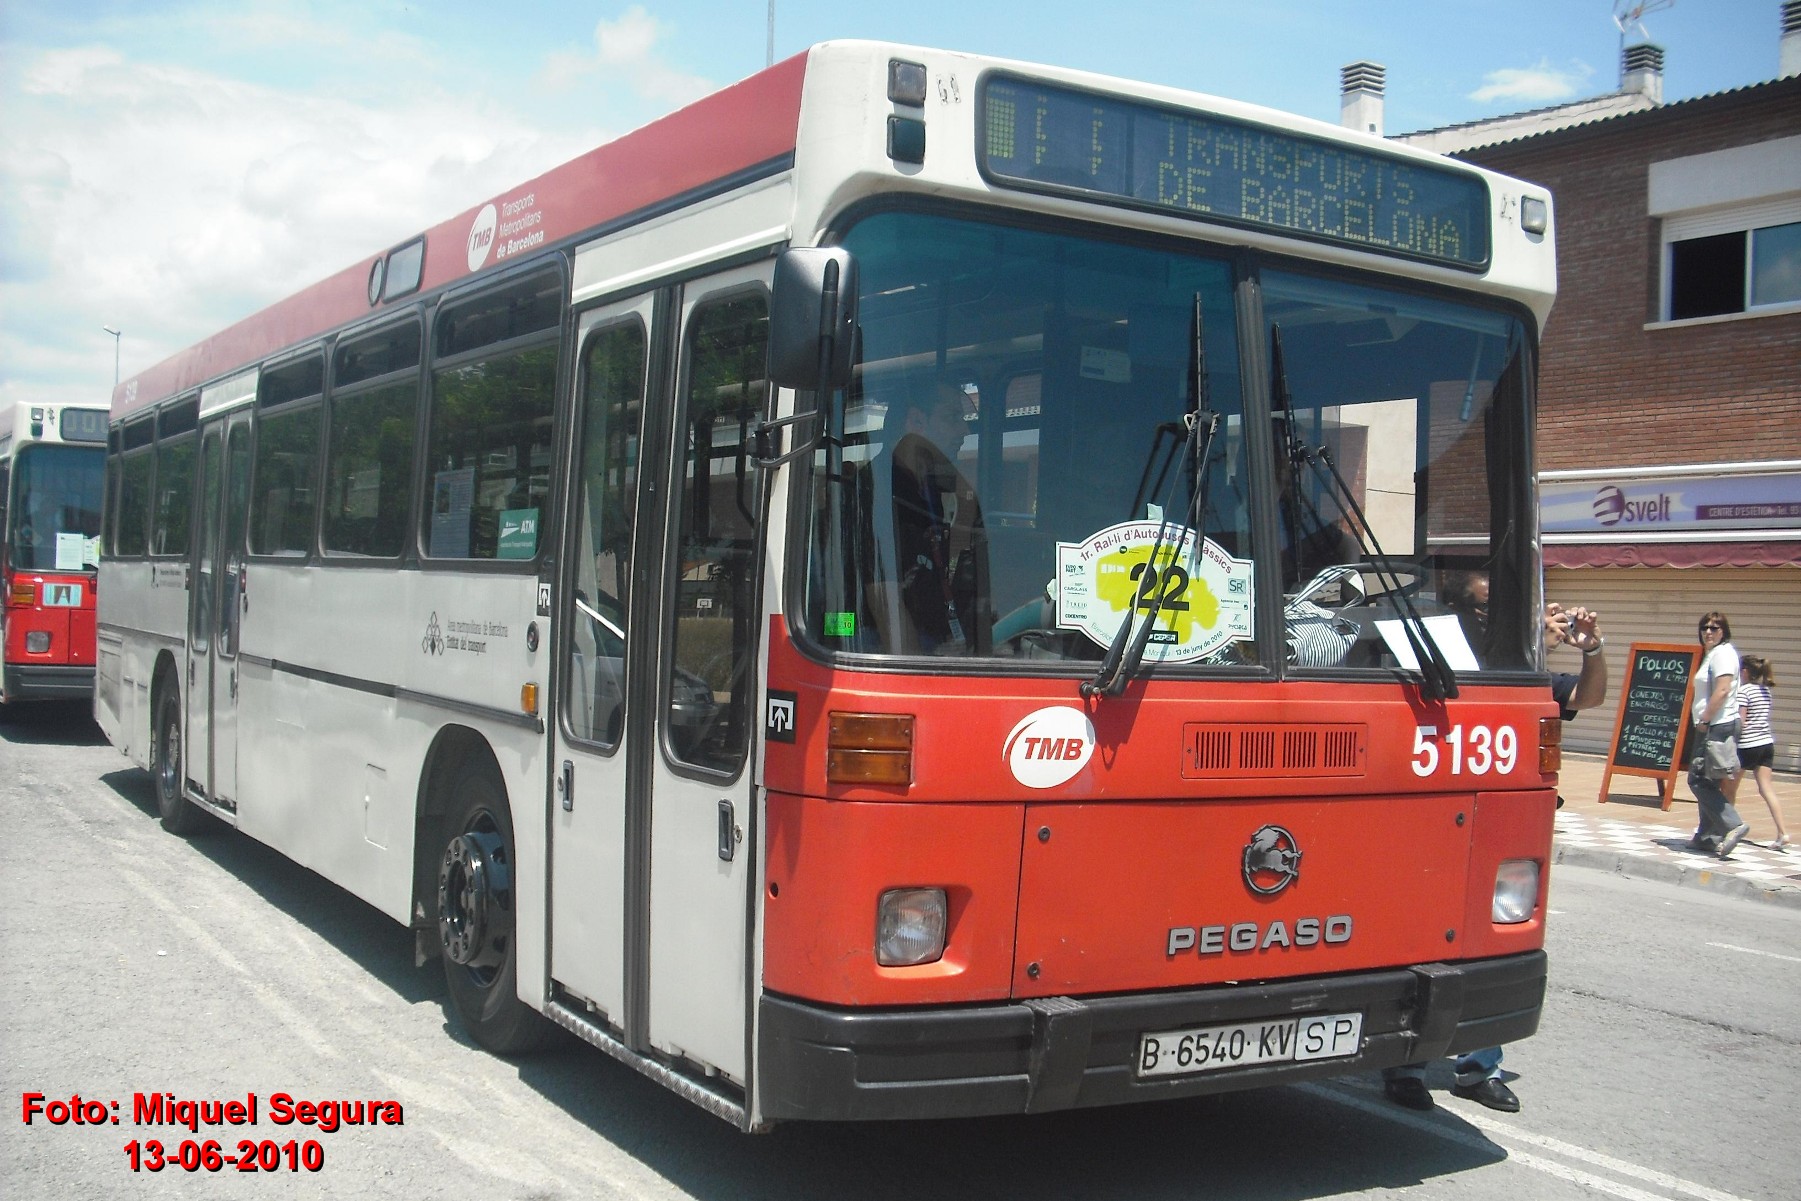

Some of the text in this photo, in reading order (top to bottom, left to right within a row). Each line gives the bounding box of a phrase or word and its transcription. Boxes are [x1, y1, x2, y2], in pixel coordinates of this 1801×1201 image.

[1161, 113, 1415, 206] TRANSPORTS
[502, 193, 535, 218] Transports
[1158, 162, 1213, 213] DE
[1241, 178, 1461, 258] BARCELONA
[498, 211, 542, 239] Metropolitans
[472, 226, 492, 252] TMB
[496, 230, 545, 259] de Barcelona
[520, 519, 535, 534] ATM
[1080, 549, 1094, 562] 1r.
[1129, 562, 1190, 611] 22
[1175, 648, 1182, 656] 13
[1210, 630, 1223, 643] 2010
[1639, 656, 1685, 675] POLLOS
[1653, 672, 1662, 680] A
[1629, 688, 1665, 701] CONEJOS
[1630, 700, 1670, 711] ENCARGO
[1634, 725, 1657, 736] POLLO
[1025, 737, 1084, 760] TMB
[1411, 724, 1517, 777] 5139
[1166, 914, 1353, 958] PEGASO
